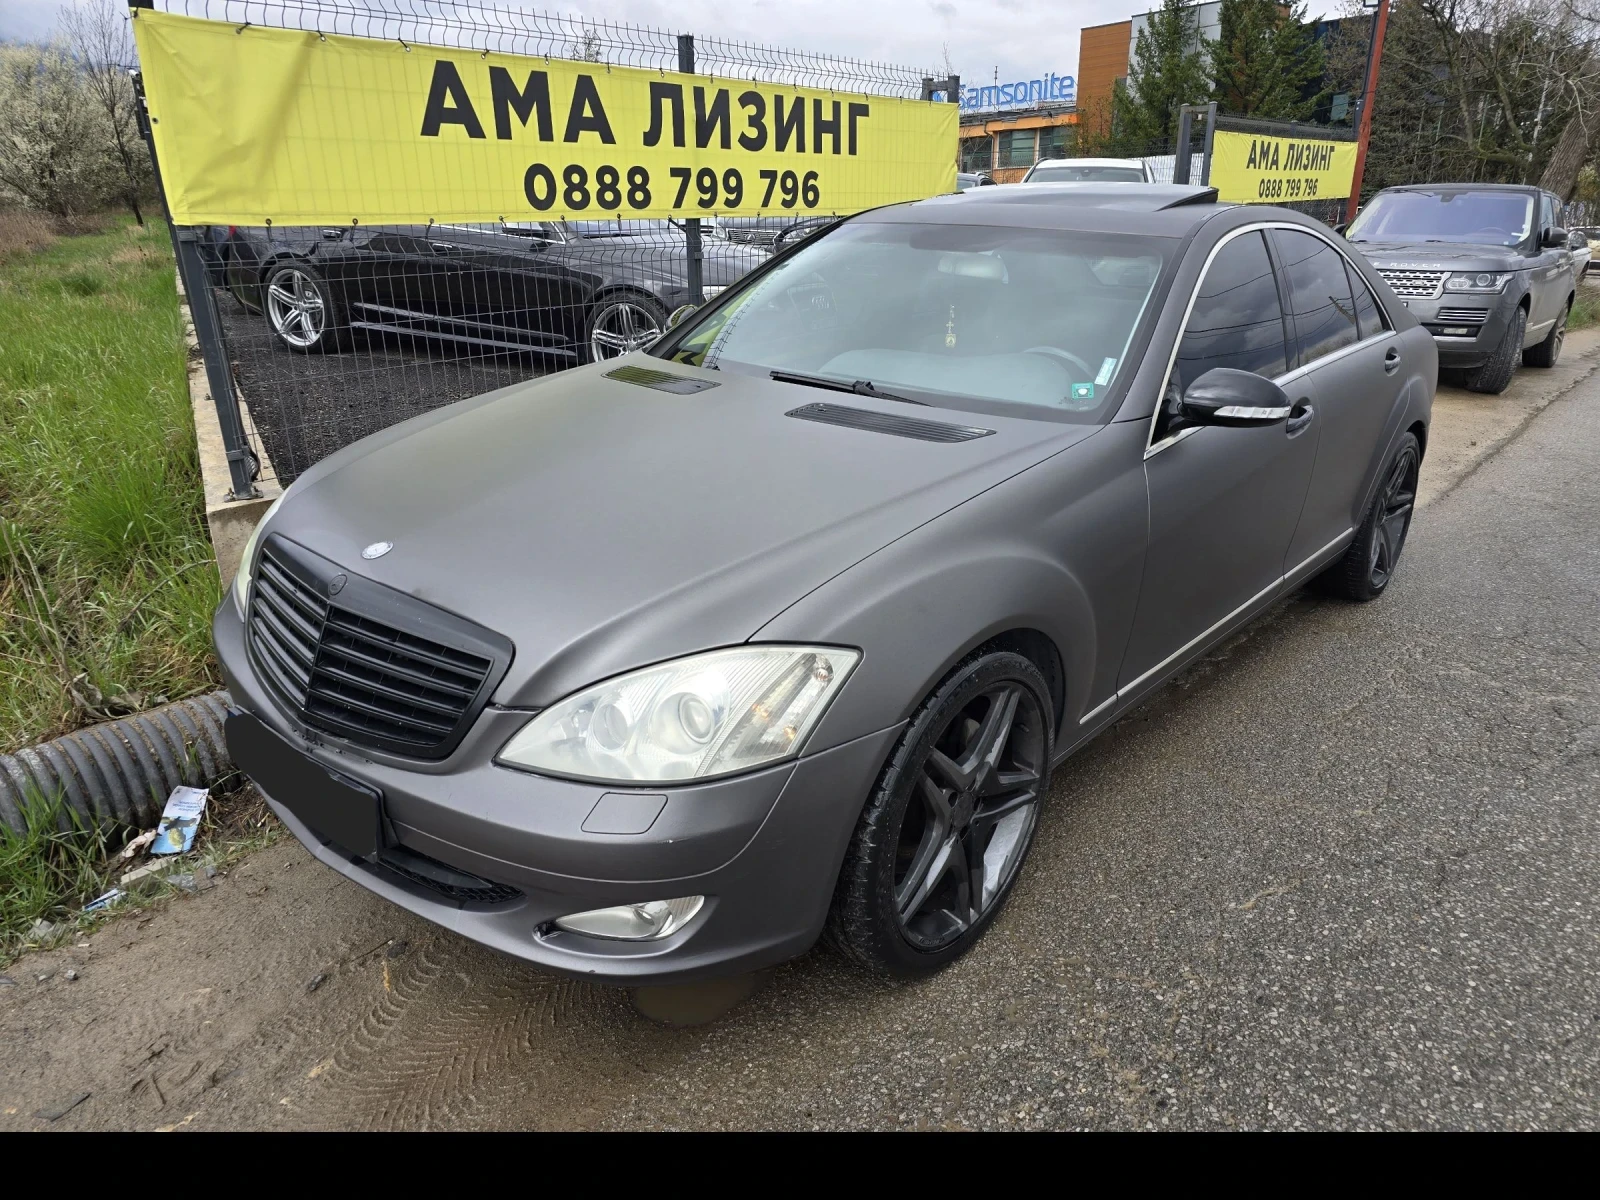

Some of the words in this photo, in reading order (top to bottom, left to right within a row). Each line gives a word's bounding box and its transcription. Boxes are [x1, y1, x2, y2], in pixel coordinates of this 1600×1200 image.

[420, 60, 616, 144] АМА
[643, 82, 870, 155] ЛИЗИНГ
[1246, 140, 1279, 170] АМА
[1283, 144, 1335, 171] ЛИЗИНГ
[524, 163, 652, 211] 0888
[670, 167, 744, 209] 799
[759, 170, 820, 208] 796
[1258, 178, 1282, 198] 0888
[1285, 178, 1301, 197] 799
[1303, 178, 1318, 197] 796
